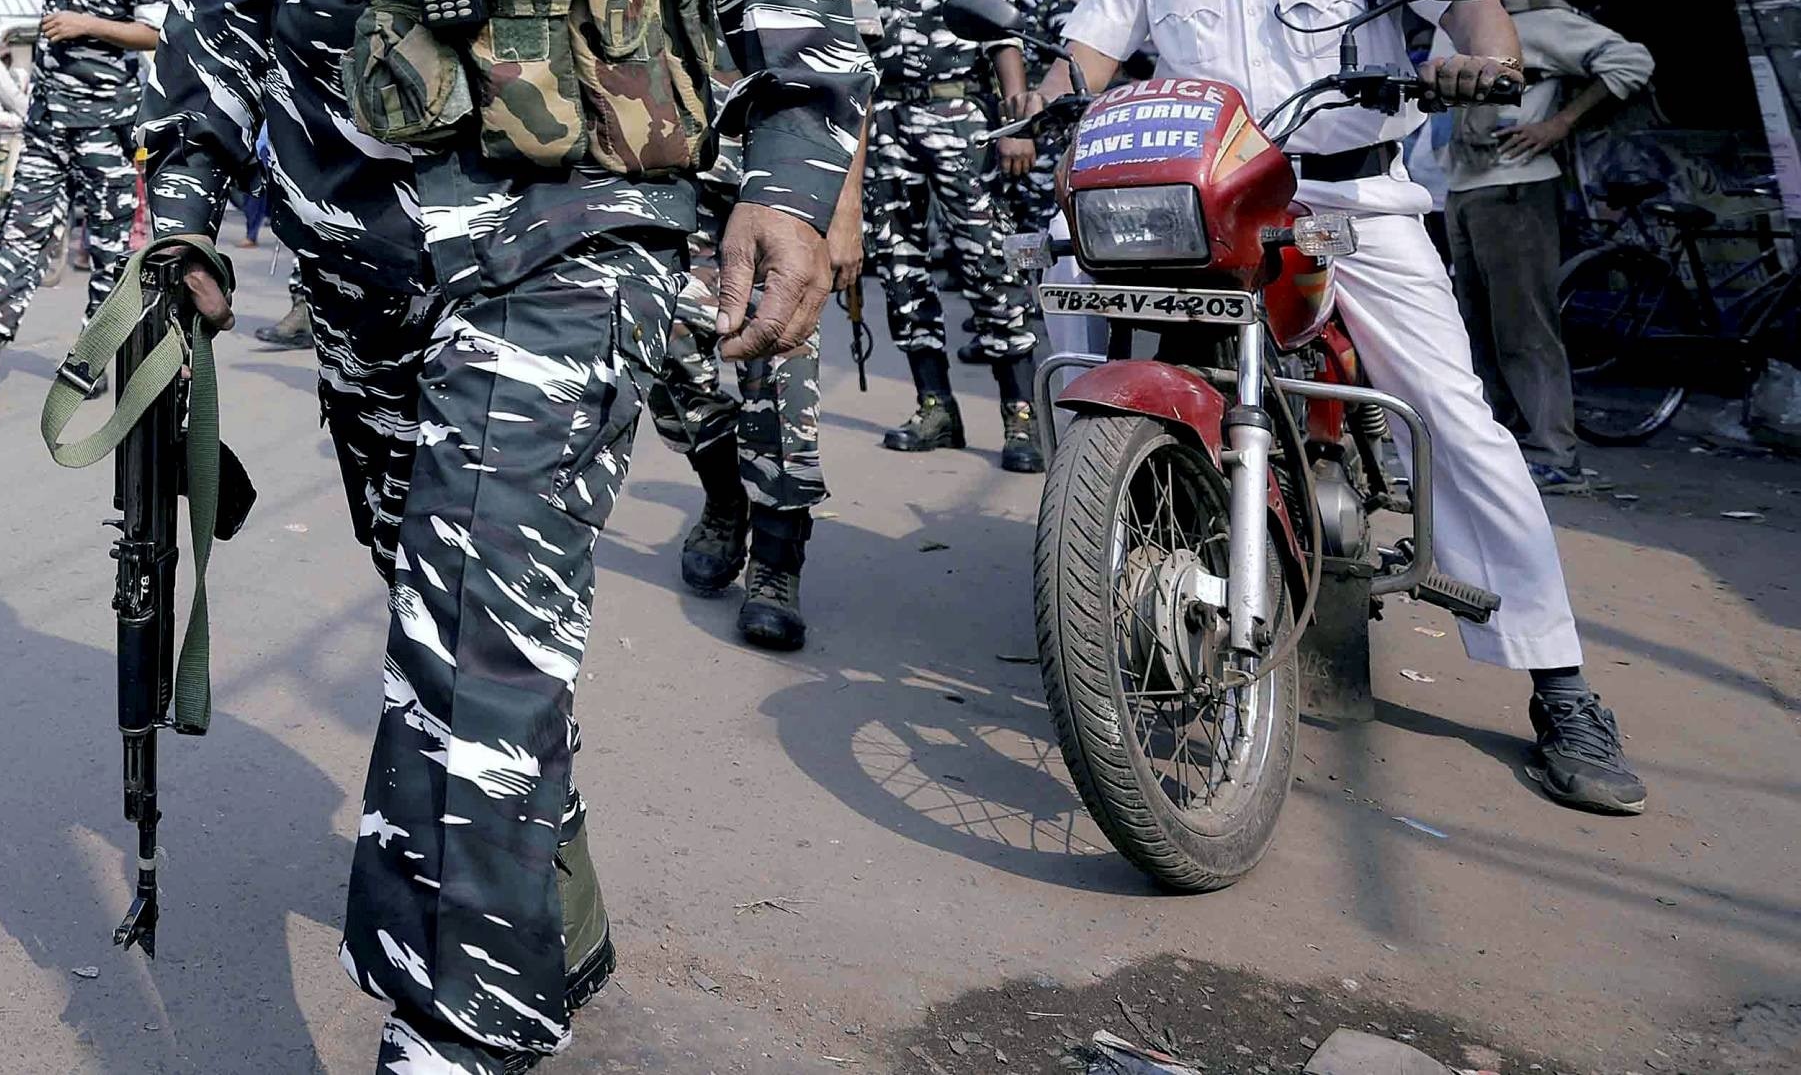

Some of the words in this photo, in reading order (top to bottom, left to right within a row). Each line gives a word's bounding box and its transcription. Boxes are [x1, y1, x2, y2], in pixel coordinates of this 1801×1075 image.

[1079, 108, 1132, 134] SAFE
[1135, 104, 1215, 122] DRIVE
[1075, 133, 1134, 159] SAVE
